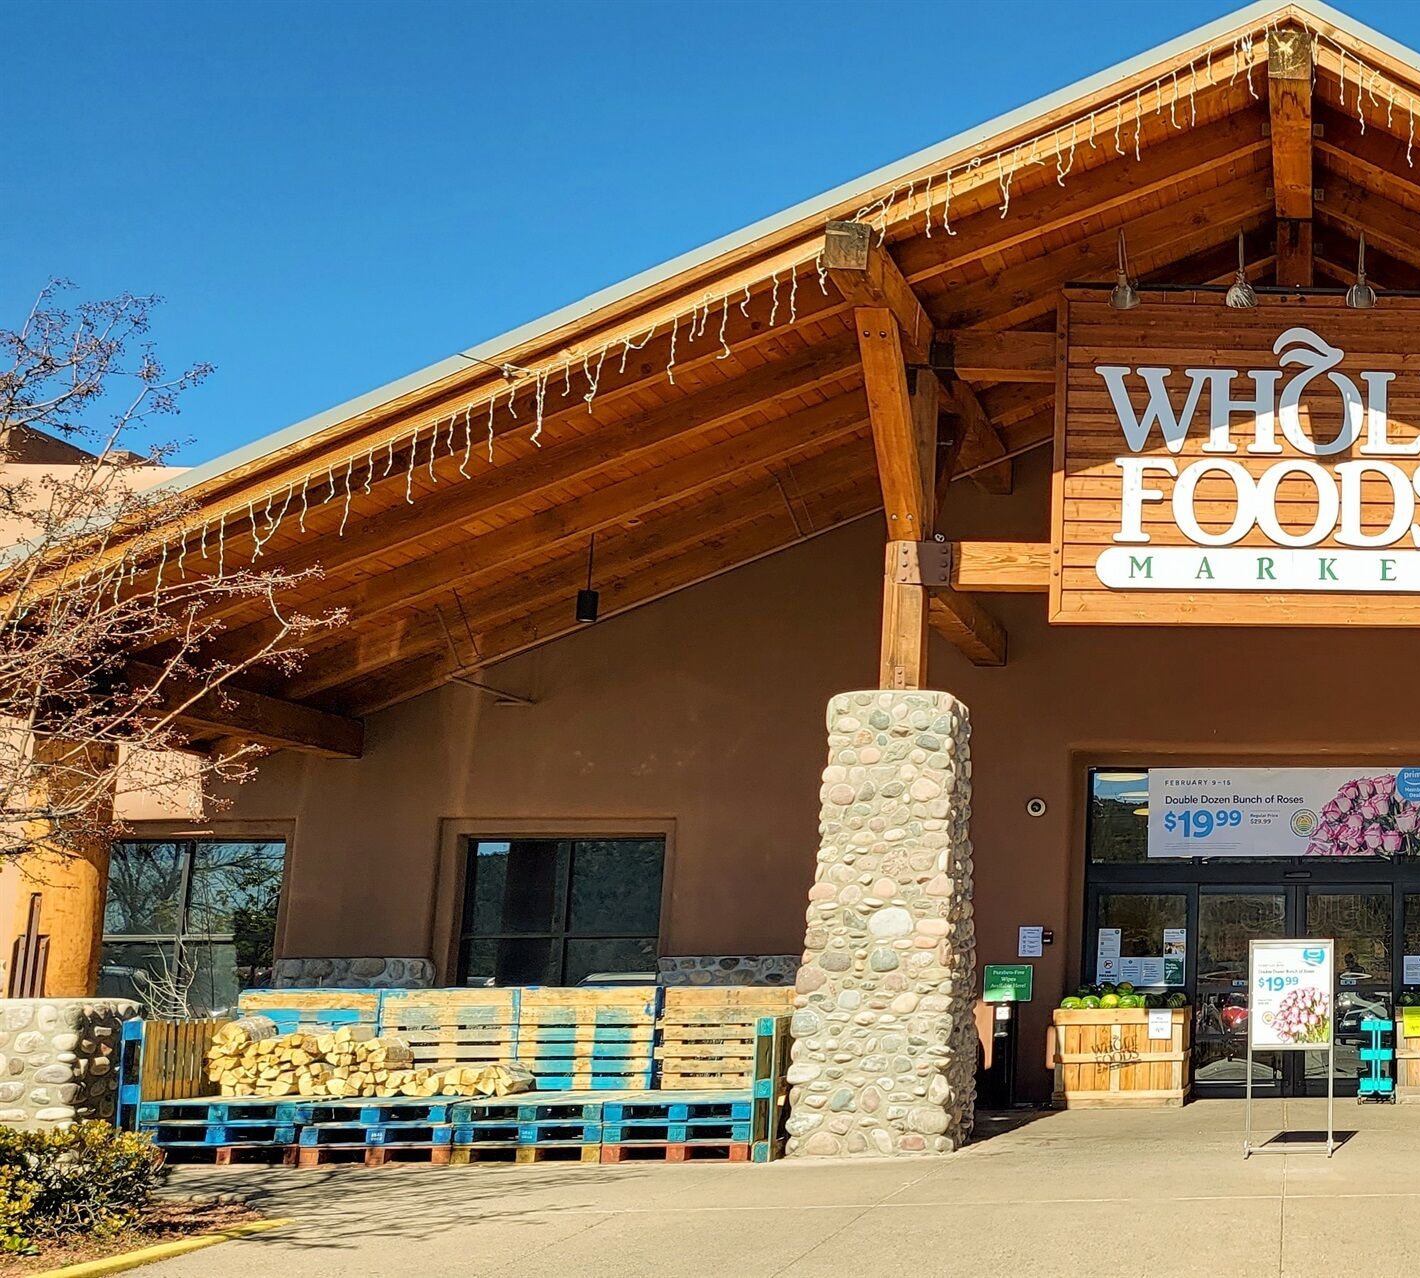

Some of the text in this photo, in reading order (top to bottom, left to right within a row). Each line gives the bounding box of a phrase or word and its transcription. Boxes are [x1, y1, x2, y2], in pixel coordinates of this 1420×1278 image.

[1165, 795, 1304, 804] Double Dozen Bunch of Roses
